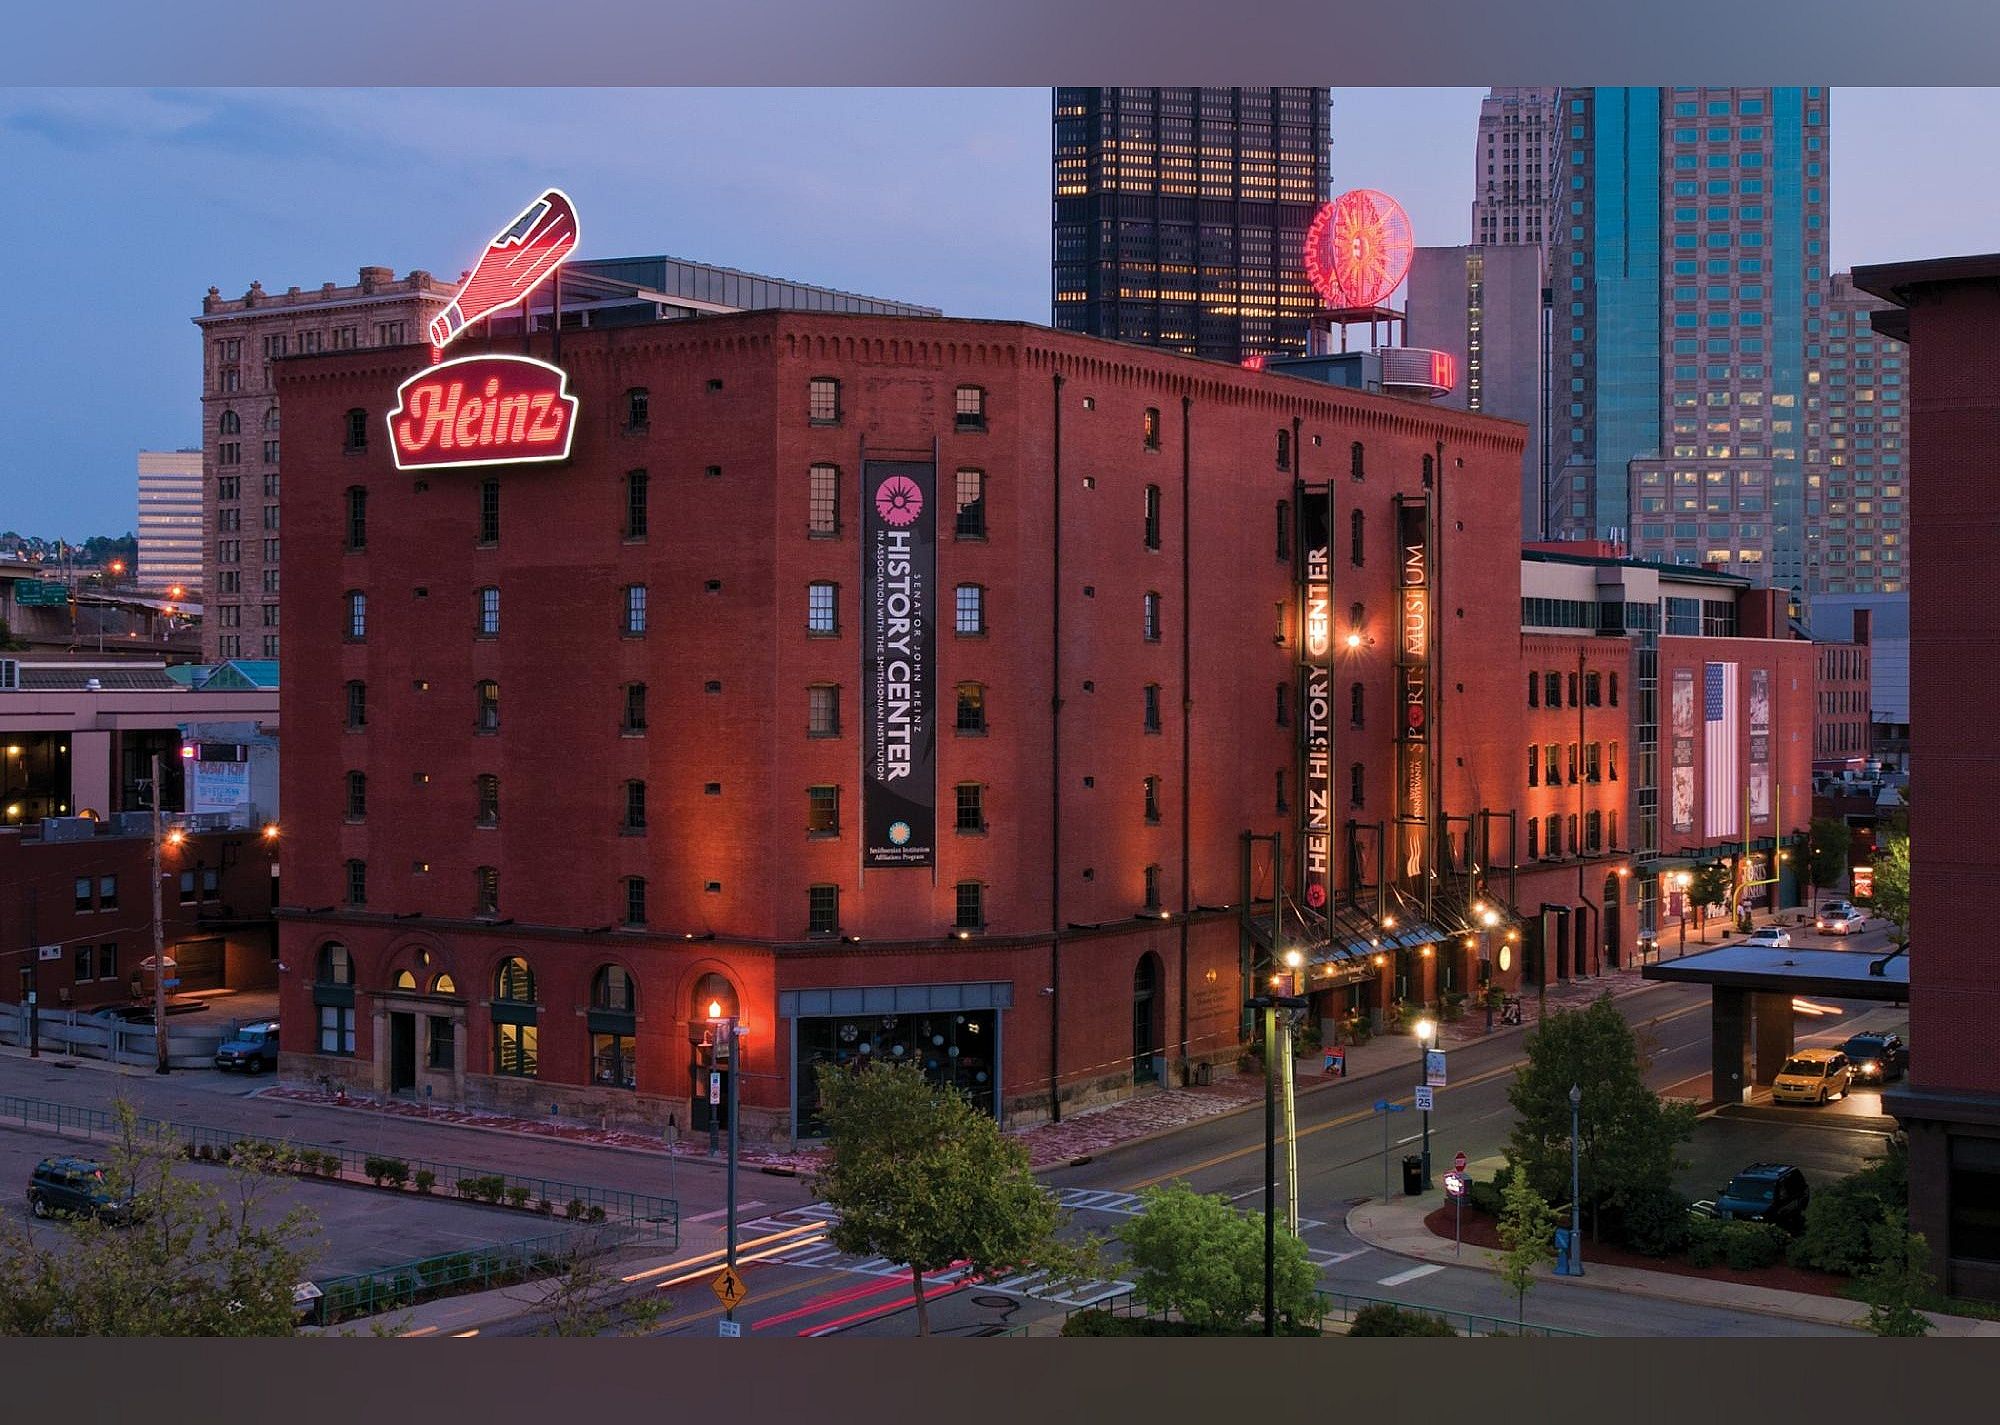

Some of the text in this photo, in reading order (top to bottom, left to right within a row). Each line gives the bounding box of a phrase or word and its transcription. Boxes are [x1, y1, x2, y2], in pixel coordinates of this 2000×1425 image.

[399, 378, 564, 451] Heinz
[877, 530, 885, 780] IN ASSOCIATION WITH THE SMITHSONIAN INSTITUTION
[888, 531, 911, 782] HISTORY CENTER
[1308, 546, 1328, 873] HENZ HISTORY CENTER
[1418, 1098, 1431, 1108] 25
